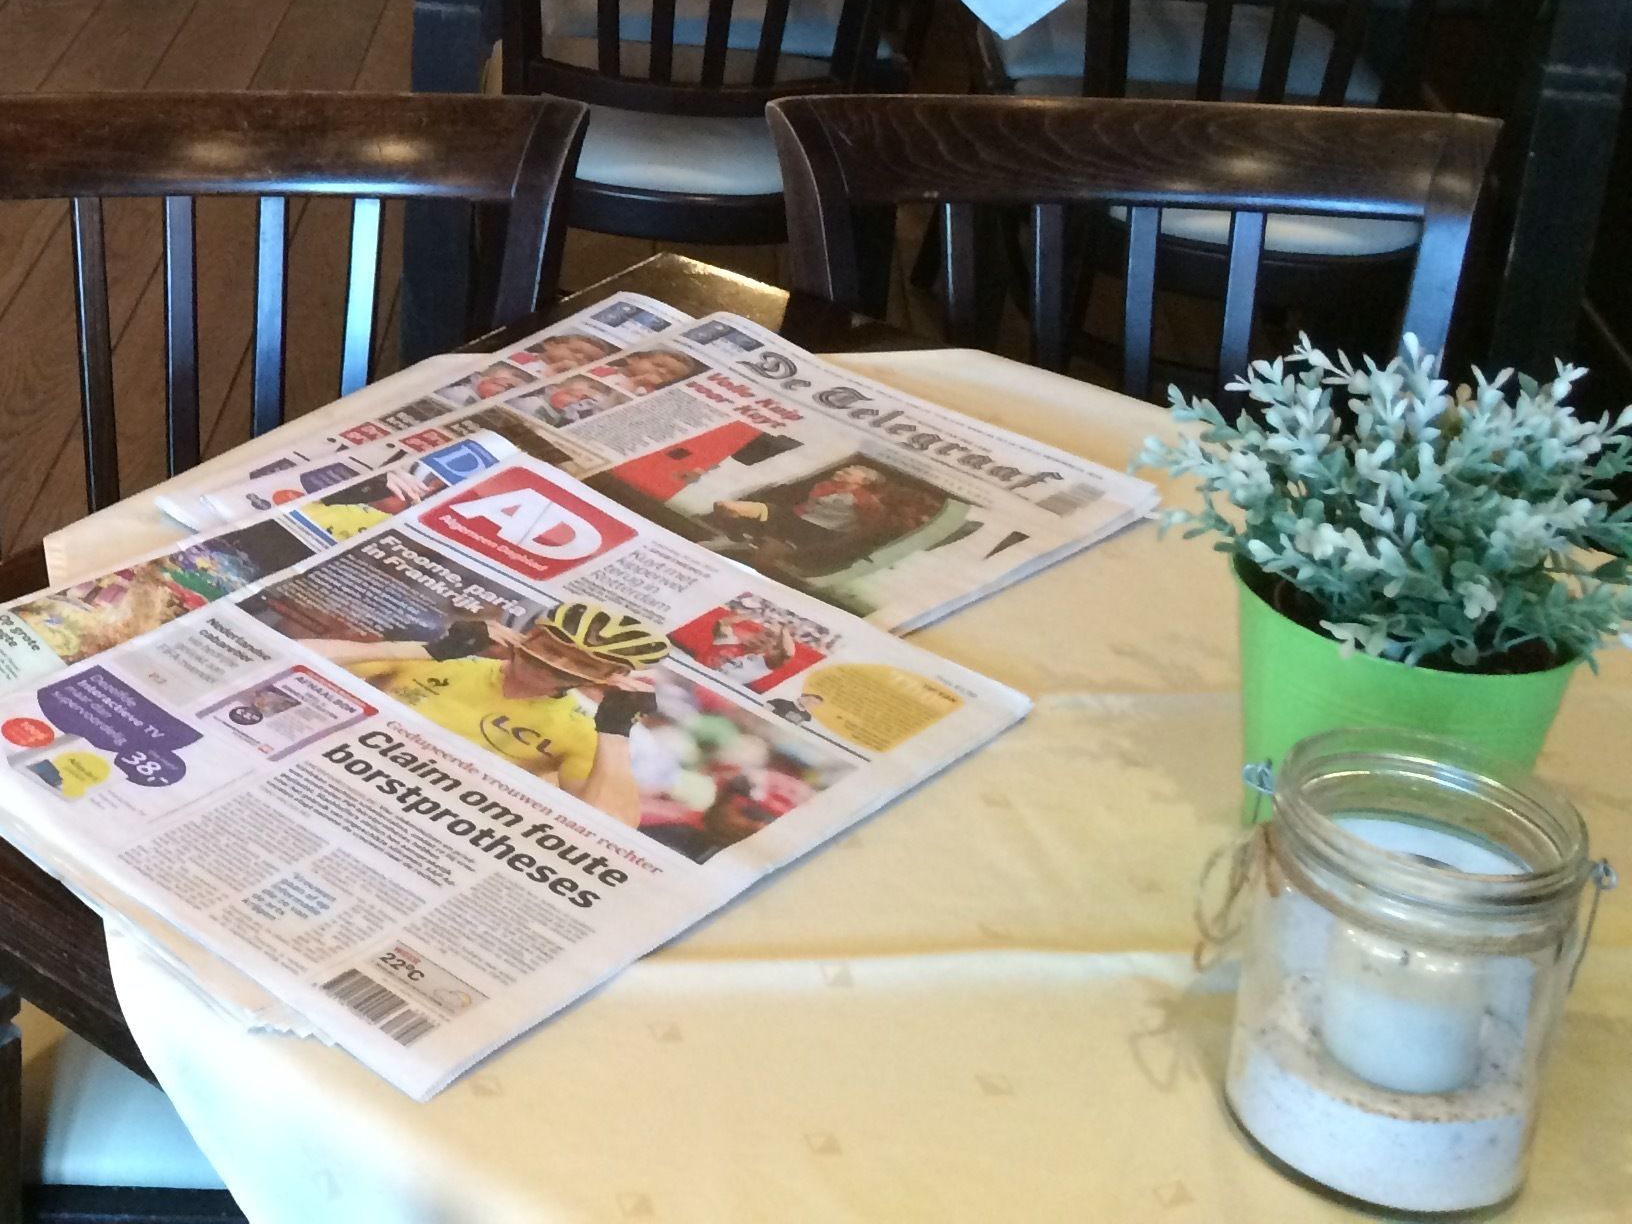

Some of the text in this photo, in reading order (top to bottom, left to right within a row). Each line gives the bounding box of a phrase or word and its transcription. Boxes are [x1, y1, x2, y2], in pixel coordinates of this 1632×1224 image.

[686, 381, 786, 428] voor Kuyt
[707, 373, 804, 421] Volle Kuip
[736, 351, 811, 391] De
[813, 386, 1063, 490] Telegraaf
[439, 515, 548, 572] Algemeen Dagblad
[449, 488, 603, 560] AD
[361, 543, 485, 614] in Frankrijk
[379, 535, 463, 588] Froome,
[465, 584, 528, 618] paria
[7, 628, 42, 652] grote
[206, 619, 272, 660] Nederlandse
[76, 680, 165, 739] Interactieve TV
[87, 674, 140, 707] Dezelfde
[492, 714, 555, 757] LCL
[121, 752, 170, 788] 38,-
[386, 720, 664, 874] Gedupeerde vrouwen naar rechter
[322, 742, 601, 909] borstprotheses
[357, 730, 460, 793] Claim
[458, 785, 524, 827] om
[522, 818, 629, 888] foute
